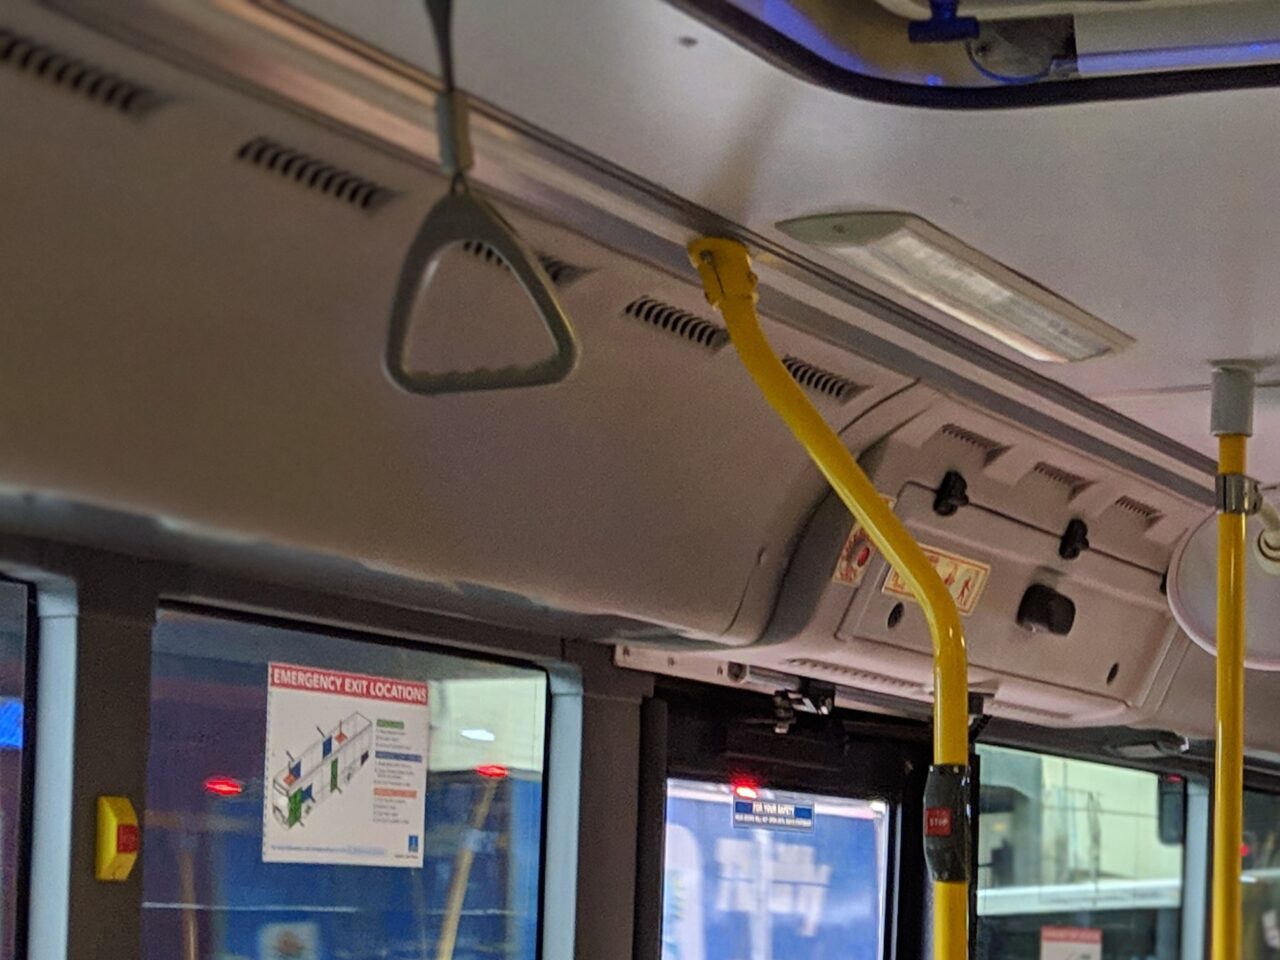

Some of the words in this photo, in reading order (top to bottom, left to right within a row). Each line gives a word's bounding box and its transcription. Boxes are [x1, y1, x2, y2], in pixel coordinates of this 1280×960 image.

[273, 668, 342, 692] EMERGENCY
[344, 677, 369, 694] EXIT
[370, 681, 427, 703] LOCATIONS
